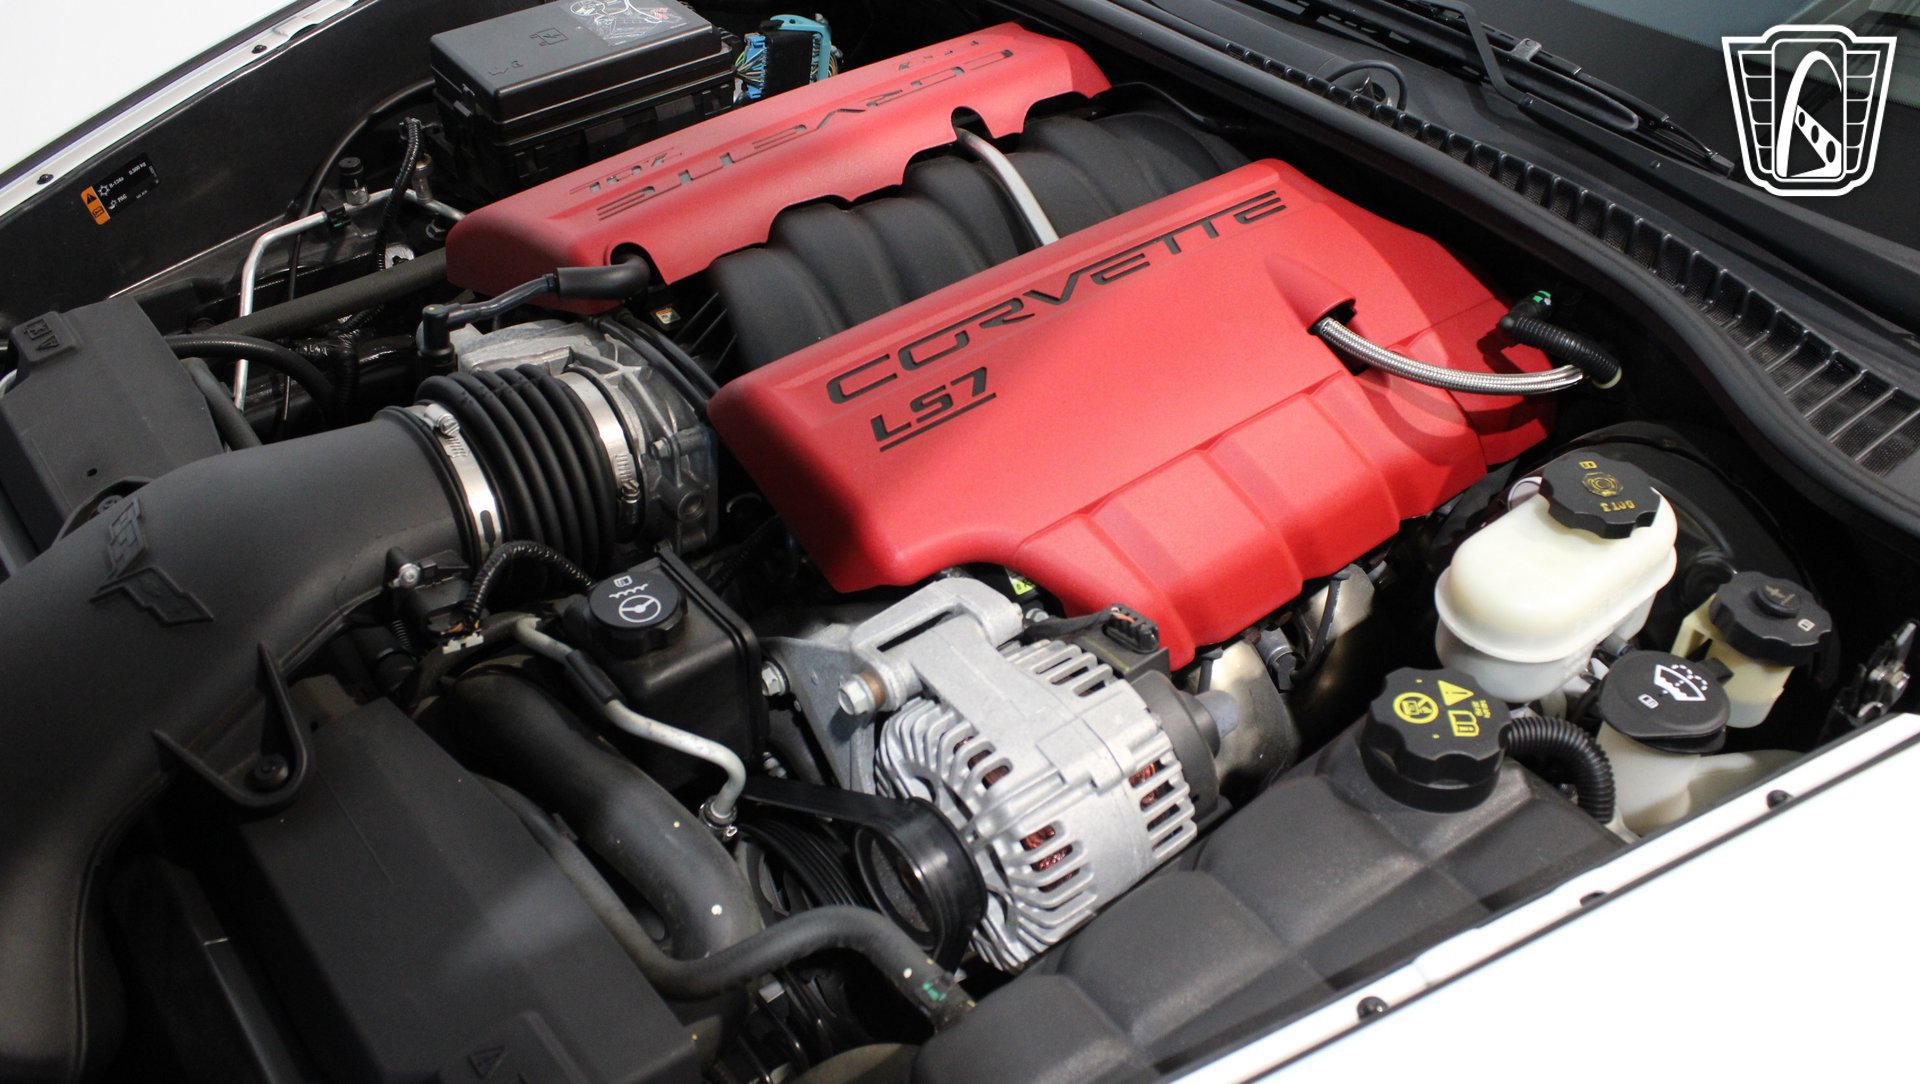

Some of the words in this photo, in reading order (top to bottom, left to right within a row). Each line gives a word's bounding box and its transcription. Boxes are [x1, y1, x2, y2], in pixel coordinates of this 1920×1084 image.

[596, 49, 1014, 221] CORVETTE
[825, 189, 1287, 405] CORVETTE
[869, 366, 988, 443] LS7
